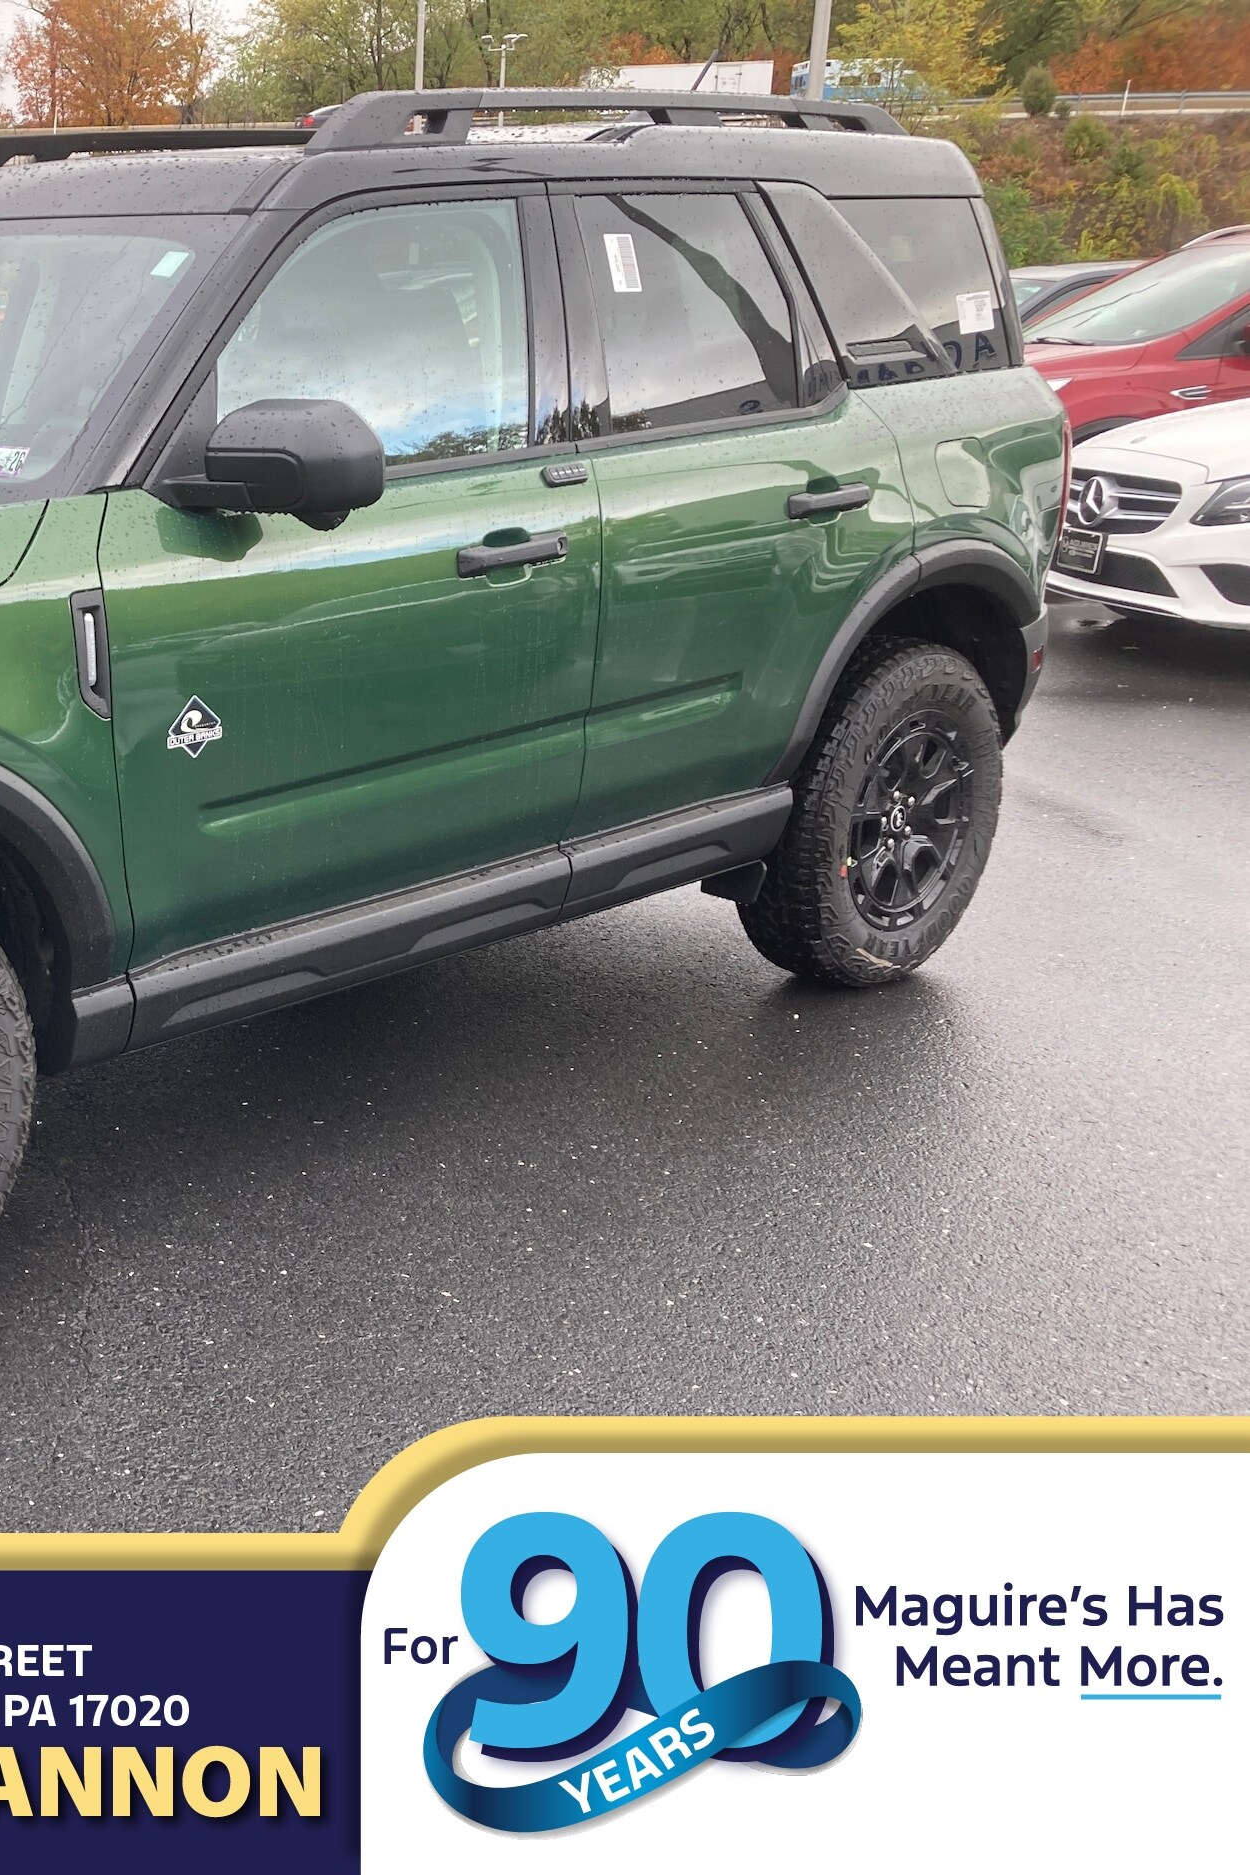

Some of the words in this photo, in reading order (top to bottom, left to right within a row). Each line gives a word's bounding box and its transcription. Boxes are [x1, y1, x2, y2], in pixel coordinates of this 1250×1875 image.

[8, 450, 26, 472] 26
[170, 734, 194, 746] OUTER
[195, 729, 220, 741] BANKS
